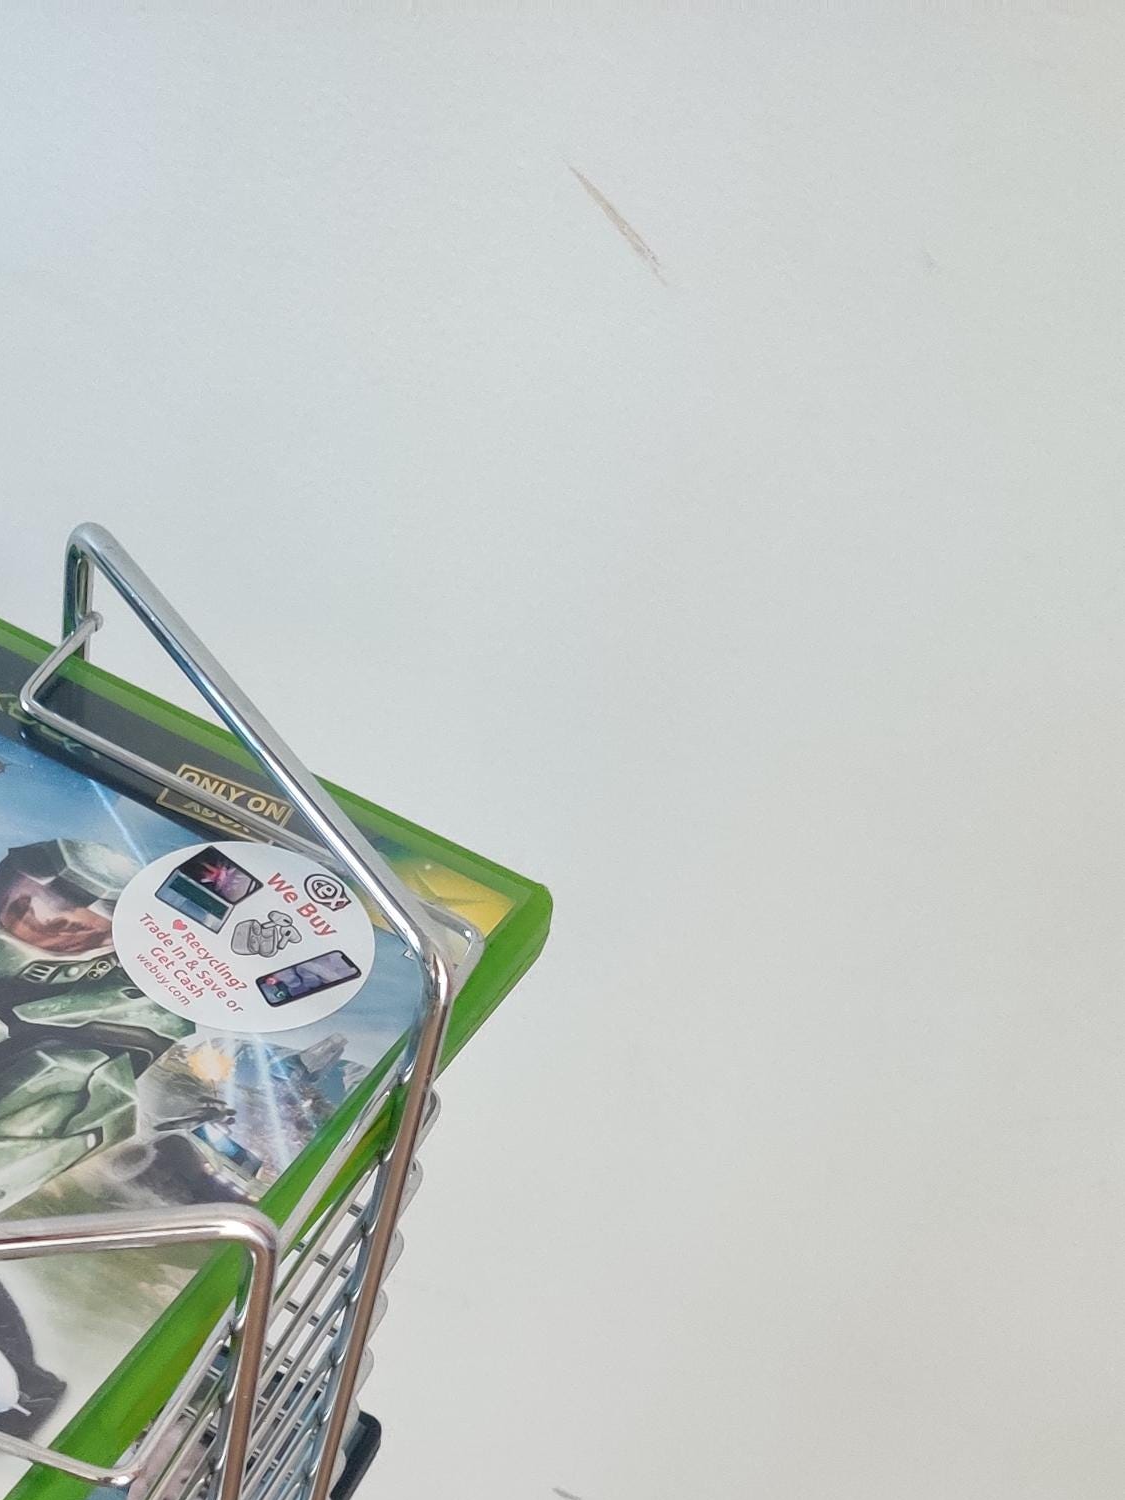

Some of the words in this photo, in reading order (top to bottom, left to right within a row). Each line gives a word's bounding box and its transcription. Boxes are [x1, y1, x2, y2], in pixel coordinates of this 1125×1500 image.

[180, 772, 247, 802] ONLY
[247, 796, 287, 821] ON
[267, 872, 298, 904] We
[296, 902, 337, 937] Buy
[136, 952, 191, 1007] webuy.com
[140, 913, 174, 947] Trade
[172, 945, 187, 960] In
[185, 959, 199, 970] &
[196, 969, 227, 1000] Save
[226, 998, 244, 1013] or
[150, 946, 174, 970] Get
[173, 965, 204, 999] Cash
[181, 931, 248, 992] Recycling?
